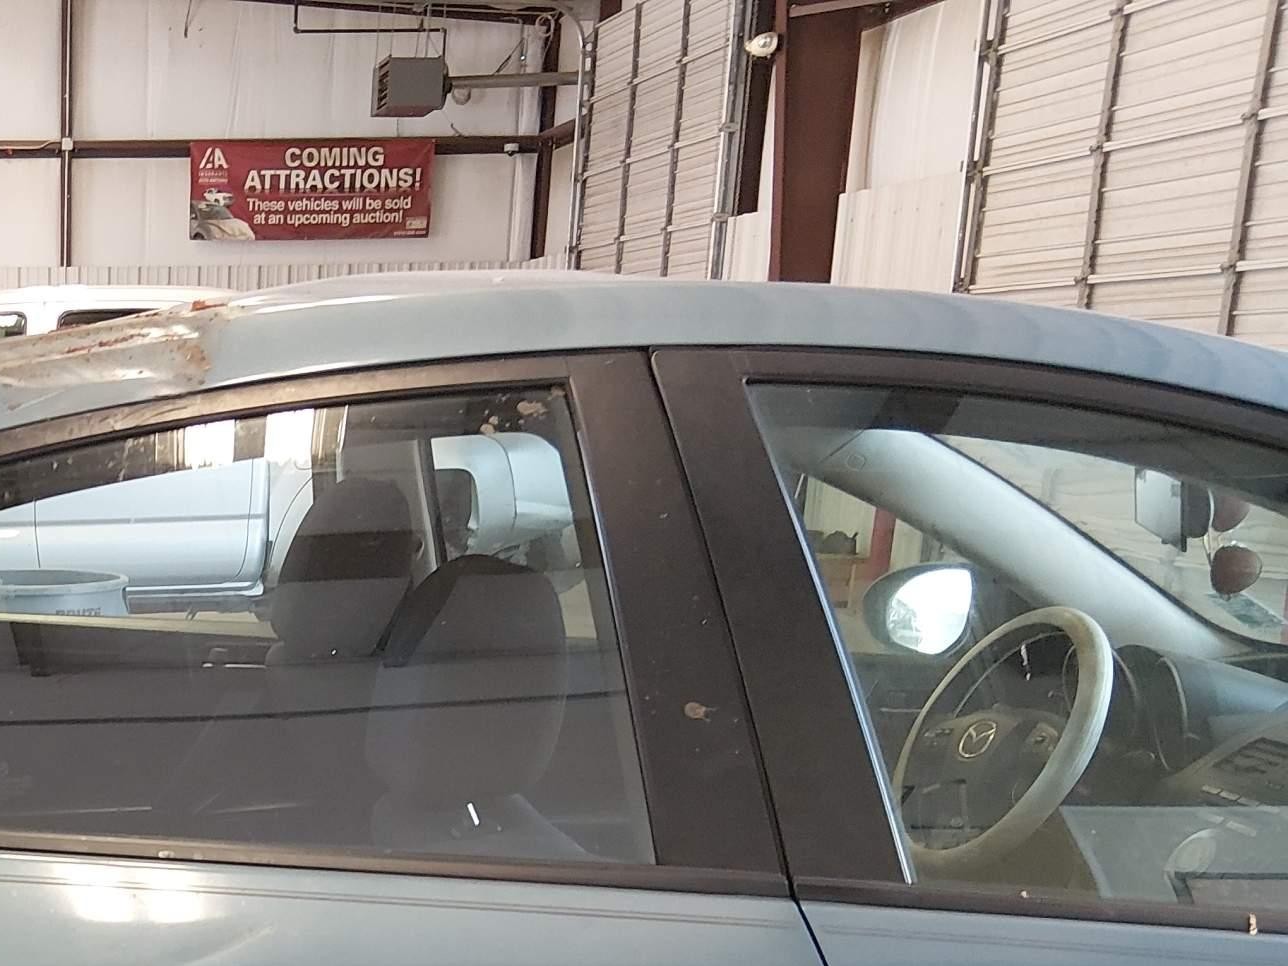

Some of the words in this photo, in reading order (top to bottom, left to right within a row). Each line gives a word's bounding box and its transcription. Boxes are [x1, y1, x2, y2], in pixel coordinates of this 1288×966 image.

[285, 147, 385, 167] COMING
[244, 168, 421, 190] ATTRACTIONS!
[247, 198, 285, 212] These
[288, 198, 339, 212] vehicles
[342, 197, 363, 210] will
[366, 197, 382, 210] be
[385, 195, 412, 210] sold
[253, 213, 265, 225] at
[268, 215, 284, 225] an
[287, 212, 350, 227] upcoming
[353, 210, 404, 224] auction!
